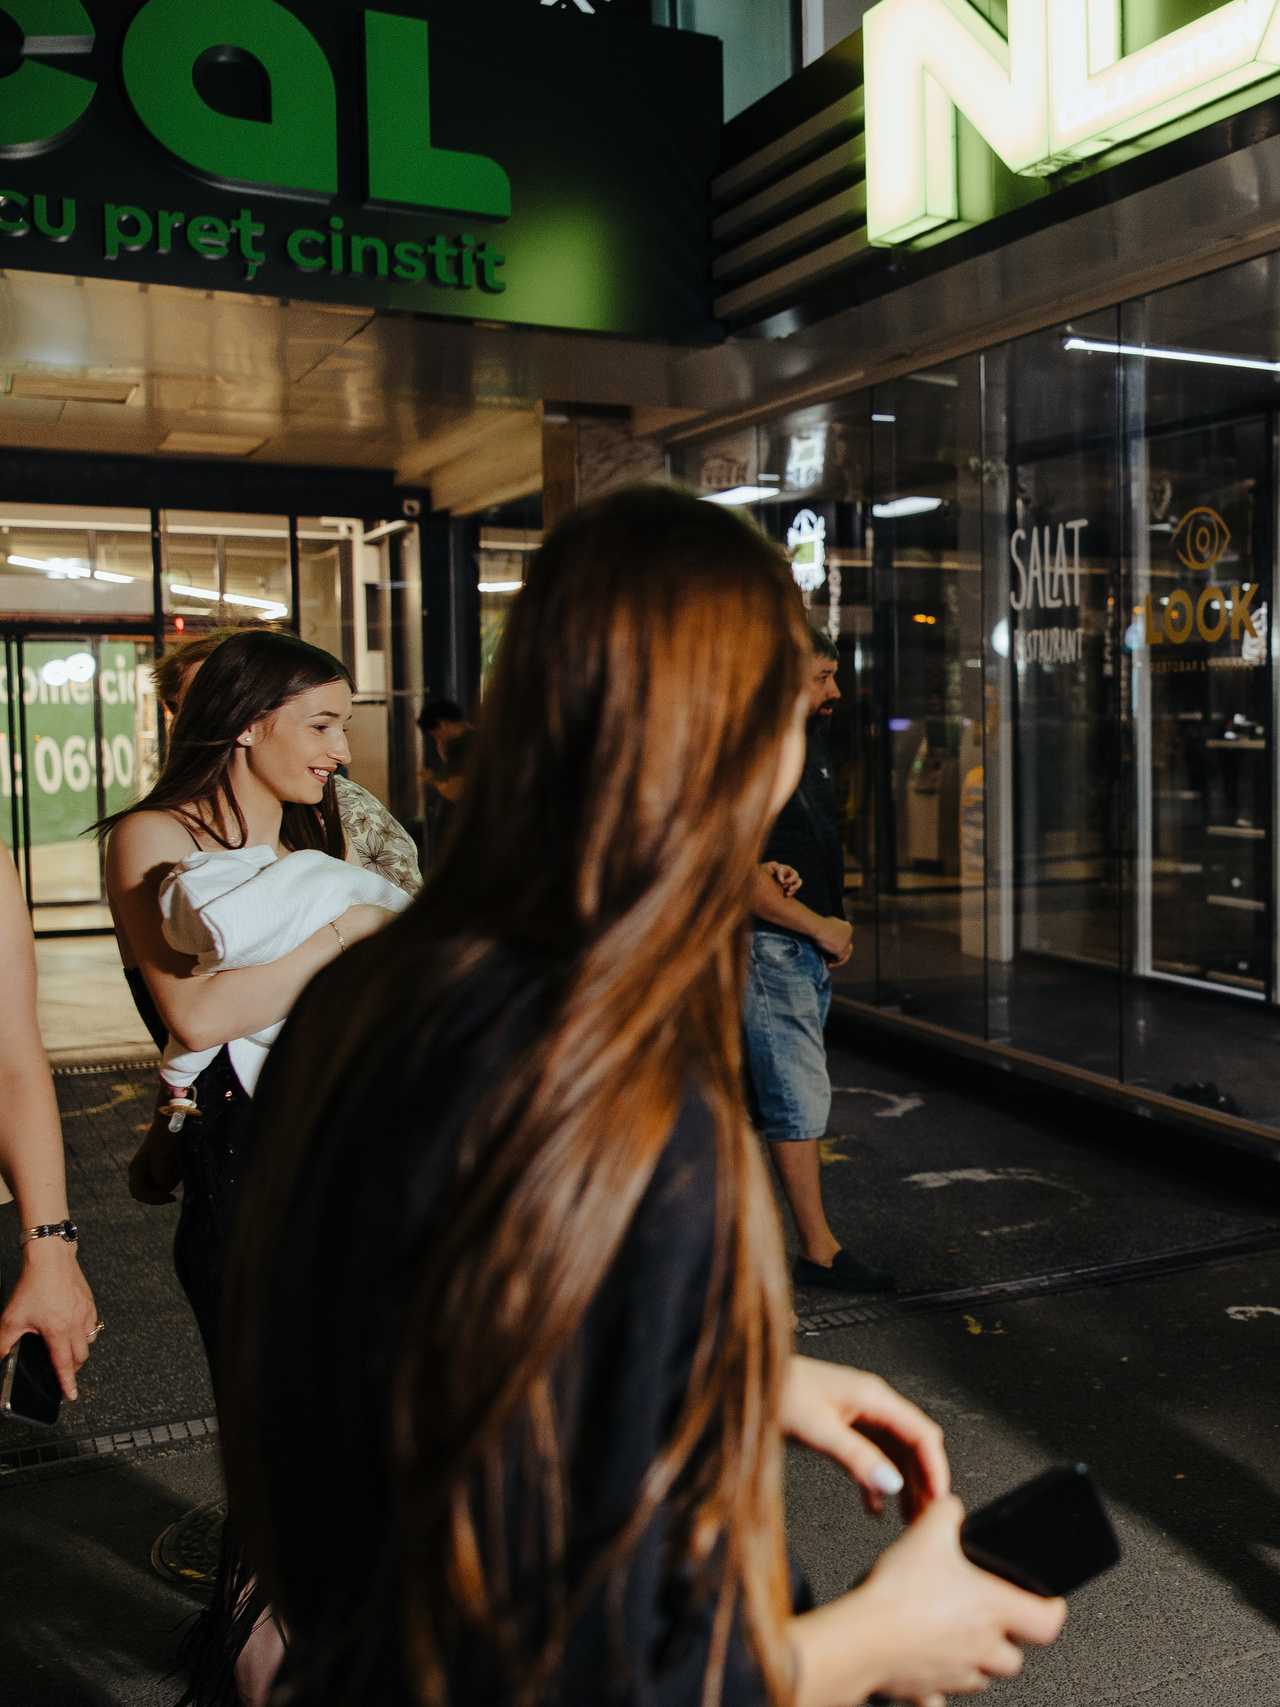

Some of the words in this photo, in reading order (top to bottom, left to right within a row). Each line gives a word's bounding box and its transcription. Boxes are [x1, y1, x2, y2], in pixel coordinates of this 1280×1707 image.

[287, 216, 507, 292] cinstit
[1010, 518, 1089, 611] SALAT
[1145, 583, 1259, 645] LOOK
